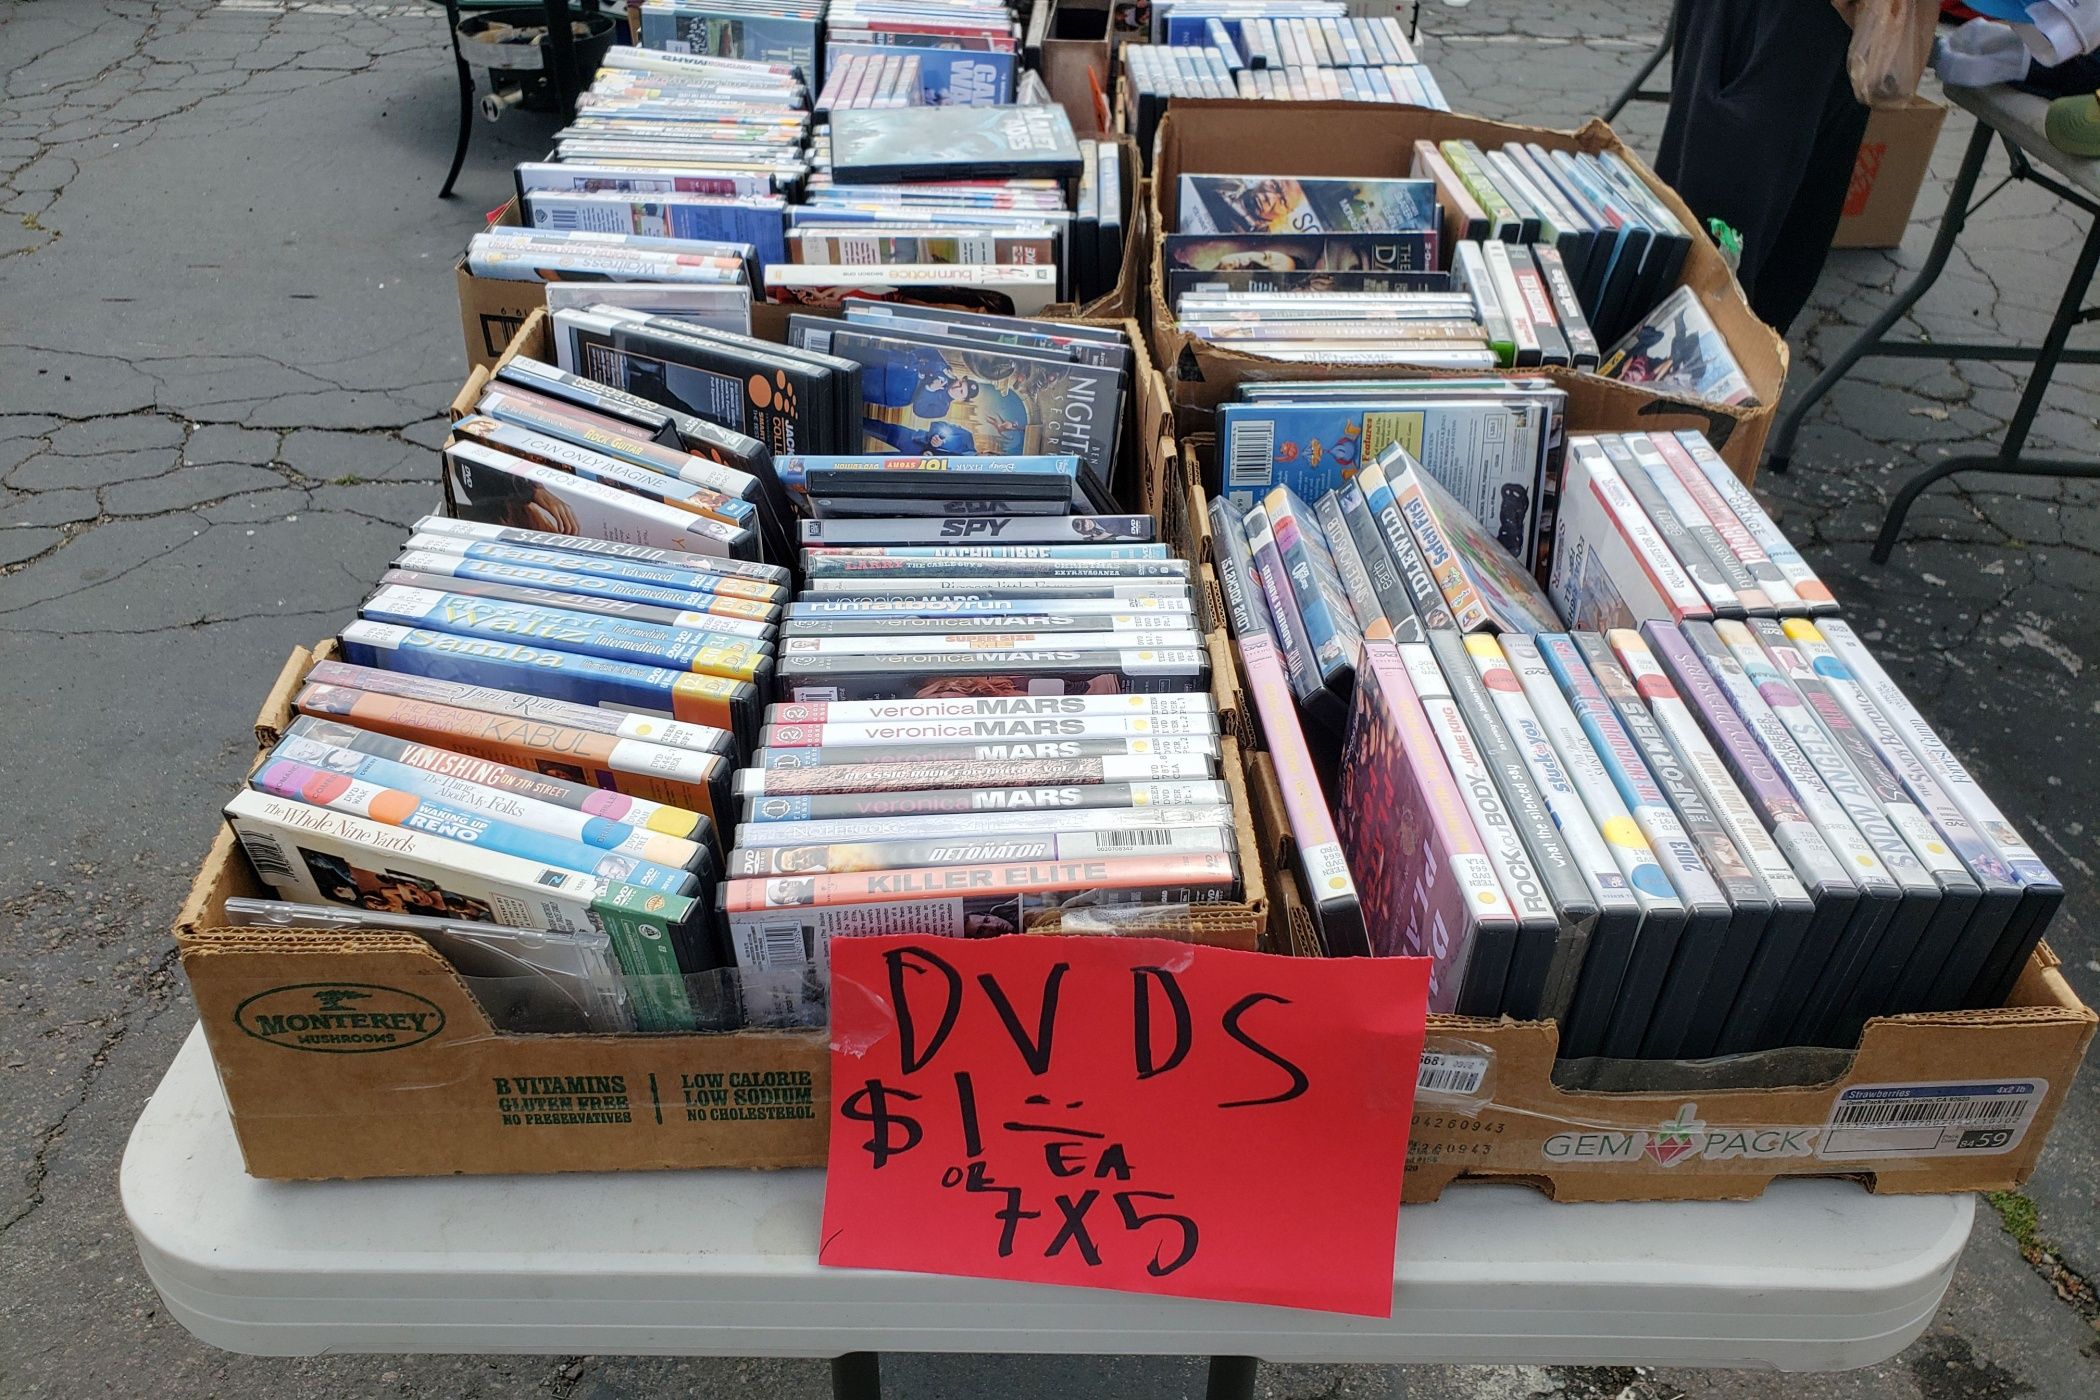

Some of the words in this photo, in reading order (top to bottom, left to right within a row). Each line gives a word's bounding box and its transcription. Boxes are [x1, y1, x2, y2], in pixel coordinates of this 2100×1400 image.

[581, 257, 657, 275] Waitress
[1061, 375, 1099, 455] NIGHT
[583, 427, 609, 443] ROCK
[609, 436, 643, 456] GUITAR
[1362, 415, 1374, 463] Features
[532, 439, 563, 457] CAN
[562, 446, 602, 468] ONLY
[599, 460, 668, 488] IMAGINE
[536, 466, 578, 486] ROAD
[939, 518, 1012, 537] SPY
[1326, 517, 1344, 543] CLUB
[475, 544, 616, 572] Tango
[617, 565, 675, 583] Advanced
[844, 560, 905, 571] LARRY
[1337, 541, 1357, 571] MOMS
[1379, 506, 1434, 601] IDLEWILD
[1423, 533, 1452, 568] Safety
[465, 560, 609, 589] Tango
[609, 583, 691, 603] Intermediate
[1220, 555, 1242, 607] ROCKETS!
[1349, 568, 1370, 603] SINGLE
[1372, 557, 1395, 591] earth
[442, 603, 593, 643] Waltz
[594, 633, 666, 655] Intermediate
[405, 628, 565, 668] Samba
[1673, 653, 1738, 732] PLEASURES
[387, 711, 461, 731] ACADEMY
[425, 703, 489, 723] BEAUTY
[1442, 706, 1461, 734] KING
[480, 716, 592, 757] KABUL
[1519, 718, 1544, 746] you
[1758, 717, 1787, 751] BIEBER
[1450, 732, 1478, 768] JAMIE
[1534, 743, 1549, 756] on
[1593, 713, 1652, 787] ENCYCLOPEDIA
[1623, 702, 1707, 823] INFORMERS
[1726, 728, 1776, 783] GUILTY
[1791, 722, 1867, 798] ANGELS
[398, 744, 504, 786] VANISHING
[500, 774, 515, 785] ON
[515, 778, 533, 792] 7TH
[532, 783, 571, 799] STREET
[422, 772, 445, 788] The
[442, 774, 475, 794] Thing
[1506, 764, 1523, 783] say
[1538, 754, 1575, 795] stuck
[1899, 752, 1932, 785] SANDY
[433, 787, 467, 803] About
[467, 793, 487, 808] My
[485, 793, 527, 818] Folks
[1518, 781, 1546, 826] silenced
[1639, 784, 1665, 802] THE
[264, 801, 285, 817] The
[283, 806, 333, 833] Whole
[334, 819, 372, 843] Nine
[370, 829, 417, 854] Yards
[408, 817, 480, 842] RENO
[417, 804, 468, 826] WAKING
[467, 817, 490, 831] UP
[1690, 814, 1713, 825] THE
[1538, 825, 1553, 844] the
[1853, 805, 1919, 868] SNOW
[928, 842, 1046, 862] DETONATOR
[1545, 842, 1567, 868] what
[1668, 840, 1702, 872] 2003
[868, 869, 994, 894] KILLER
[1004, 862, 1109, 885] ELITE
[1501, 848, 1547, 913] ROCK
[255, 1012, 428, 1037] MONTEREY
[297, 1033, 397, 1045] MUSHROOMS
[492, 1077, 511, 1095] B
[512, 1075, 627, 1095] VITAMINS
[680, 1073, 725, 1090] LOW
[728, 1070, 812, 1088] CALORIE
[1848, 1088, 1912, 1101] Strawberries
[1996, 1086, 2018, 1095] 4x2
[498, 1096, 573, 1112] GLUTEN
[576, 1095, 630, 1111] FREE
[683, 1088, 730, 1107] LOW
[733, 1087, 814, 1106] SODIUM
[502, 1113, 521, 1126] NO
[524, 1111, 633, 1125] PRESERVATIVES
[687, 1108, 707, 1122] NO
[709, 1105, 816, 1121] CHOLESTEROL
[1543, 1134, 1634, 1157] GEM
[1703, 1130, 1809, 1155] PACK
[1044, 1140, 1136, 1181] EA
